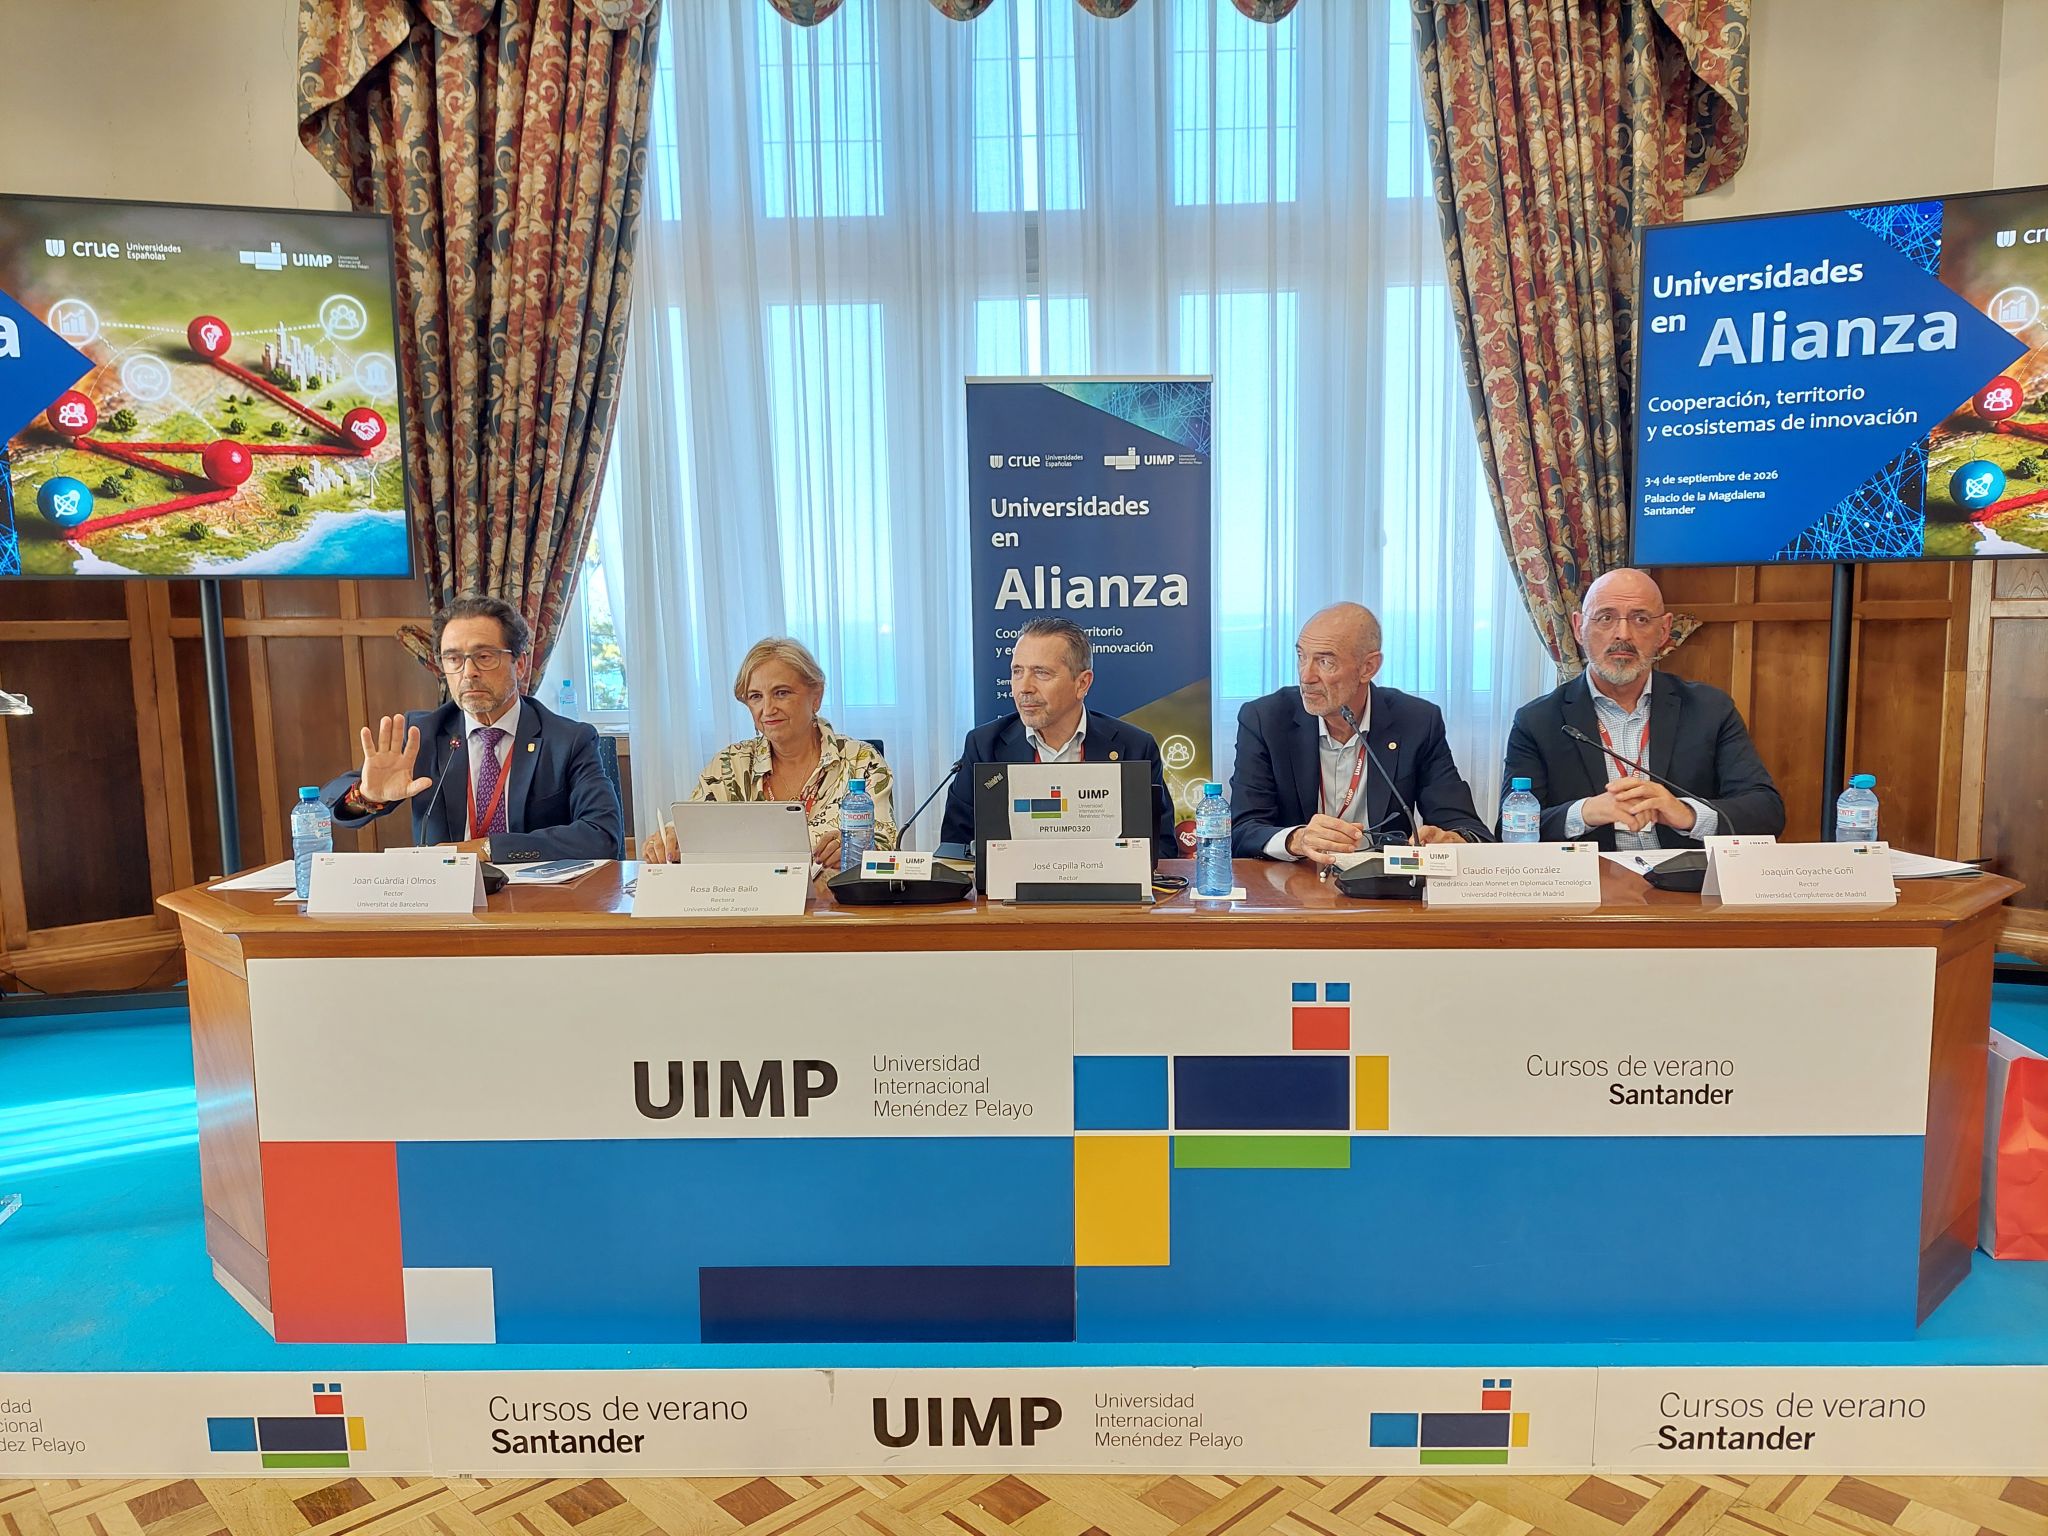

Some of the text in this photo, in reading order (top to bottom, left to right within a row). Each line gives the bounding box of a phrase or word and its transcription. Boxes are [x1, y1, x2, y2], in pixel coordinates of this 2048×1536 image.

[73, 240, 119, 259] crue
[126, 242, 181, 254] Universidades
[126, 251, 166, 262] Españolas
[292, 252, 333, 268] UIMP
[1652, 259, 1864, 299] Universidades
[1650, 312, 1686, 334] en
[1698, 308, 1958, 367] Alianza
[1647, 384, 1865, 414] Cooperación, territorio
[1646, 407, 1917, 441] y ecosistemas de innovación
[1008, 454, 1040, 468] crue
[1045, 453, 1084, 461] Universidades
[1045, 460, 1072, 468] Españolas
[1144, 454, 1175, 465] UIMP
[1645, 470, 1778, 487] 3-4 de septiembre de 2026
[1644, 489, 1765, 503] Palacio de la Magdalena
[991, 496, 1149, 518] Universidades
[1643, 504, 1696, 516] Santander
[991, 531, 1019, 548] en
[994, 566, 1188, 610] Alianza
[995, 646, 1003, 658] y
[1093, 642, 1153, 654] innovación
[1078, 789, 1109, 800] UIMP
[1039, 825, 1091, 833] PRTUIMP0320
[1032, 861, 1103, 871] José Capilla Romá
[1462, 867, 1493, 875] Claudio
[1495, 867, 1521, 876] Feijóo
[1522, 866, 1561, 875] González
[1761, 867, 1854, 877] Joaquín Goyache Goñi
[352, 877, 372, 885] Joan
[373, 877, 404, 885] Guàrdia
[410, 877, 437, 885] Olmos
[690, 885, 758, 893] Rosa Bolea Bailo
[1520, 880, 1553, 888] Diplomacia
[1554, 880, 1592, 888] Tecnológica
[873, 1055, 980, 1072] Universidad
[1526, 1054, 1734, 1077] Cursos de verano
[633, 1059, 839, 1120] UIMP
[873, 1077, 989, 1094] Internacional
[1609, 1083, 1734, 1105] Santander
[873, 1098, 1033, 1120] Menéndez Pelayo
[488, 1396, 748, 1423] Cursos de verano
[1094, 1393, 1194, 1409] Universidad
[1659, 1392, 1926, 1419] Cursos de verano
[872, 1397, 1063, 1448] UIMP
[1094, 1413, 1203, 1428] Internacional
[32, 1437, 86, 1455] Pelayo
[490, 1429, 645, 1455] Santander
[1094, 1432, 1243, 1450] Menéndez Pelayo
[1658, 1424, 1816, 1451] Santander
